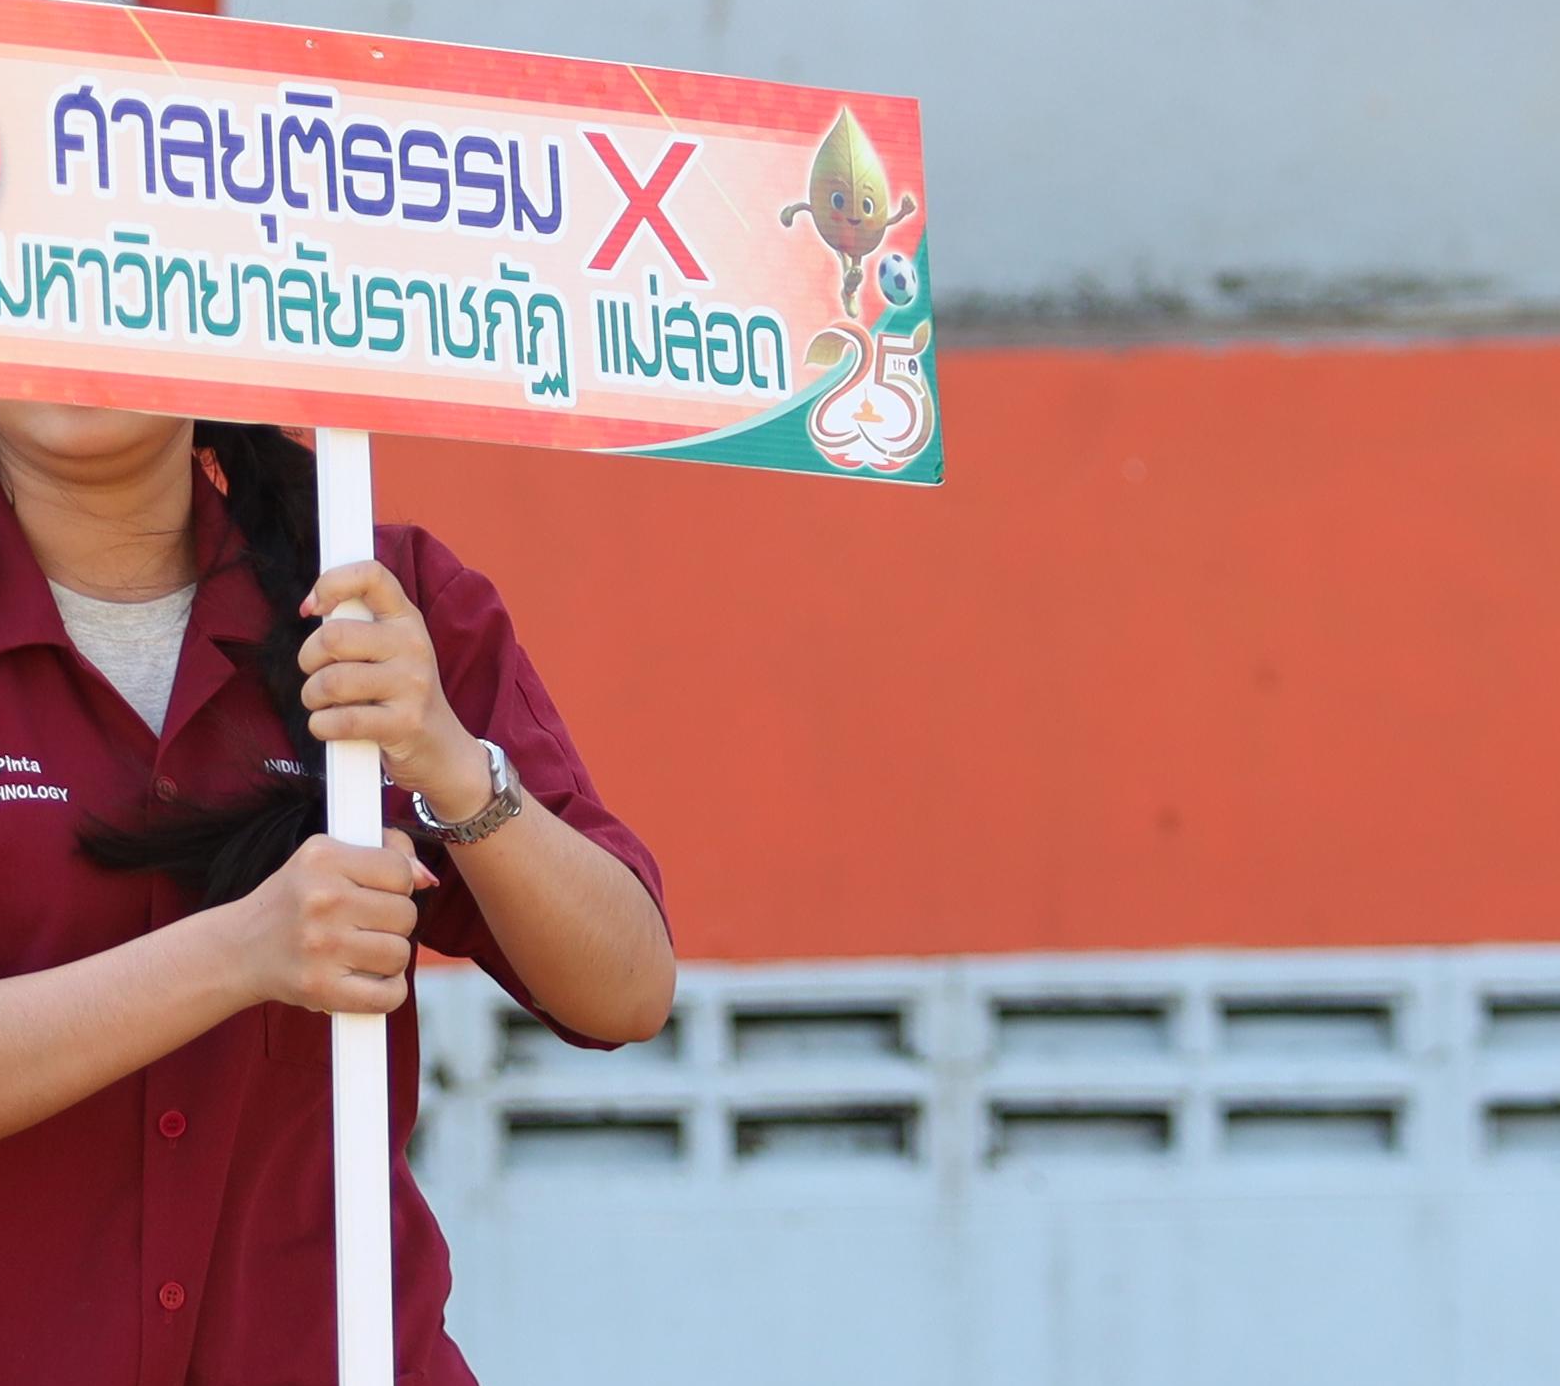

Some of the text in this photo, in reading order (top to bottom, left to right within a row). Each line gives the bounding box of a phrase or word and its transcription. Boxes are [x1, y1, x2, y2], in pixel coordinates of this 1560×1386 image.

[53, 85, 564, 243] ศาลยุติธรรม
[582, 130, 710, 282] X
[596, 273, 787, 392] แม่สอด
